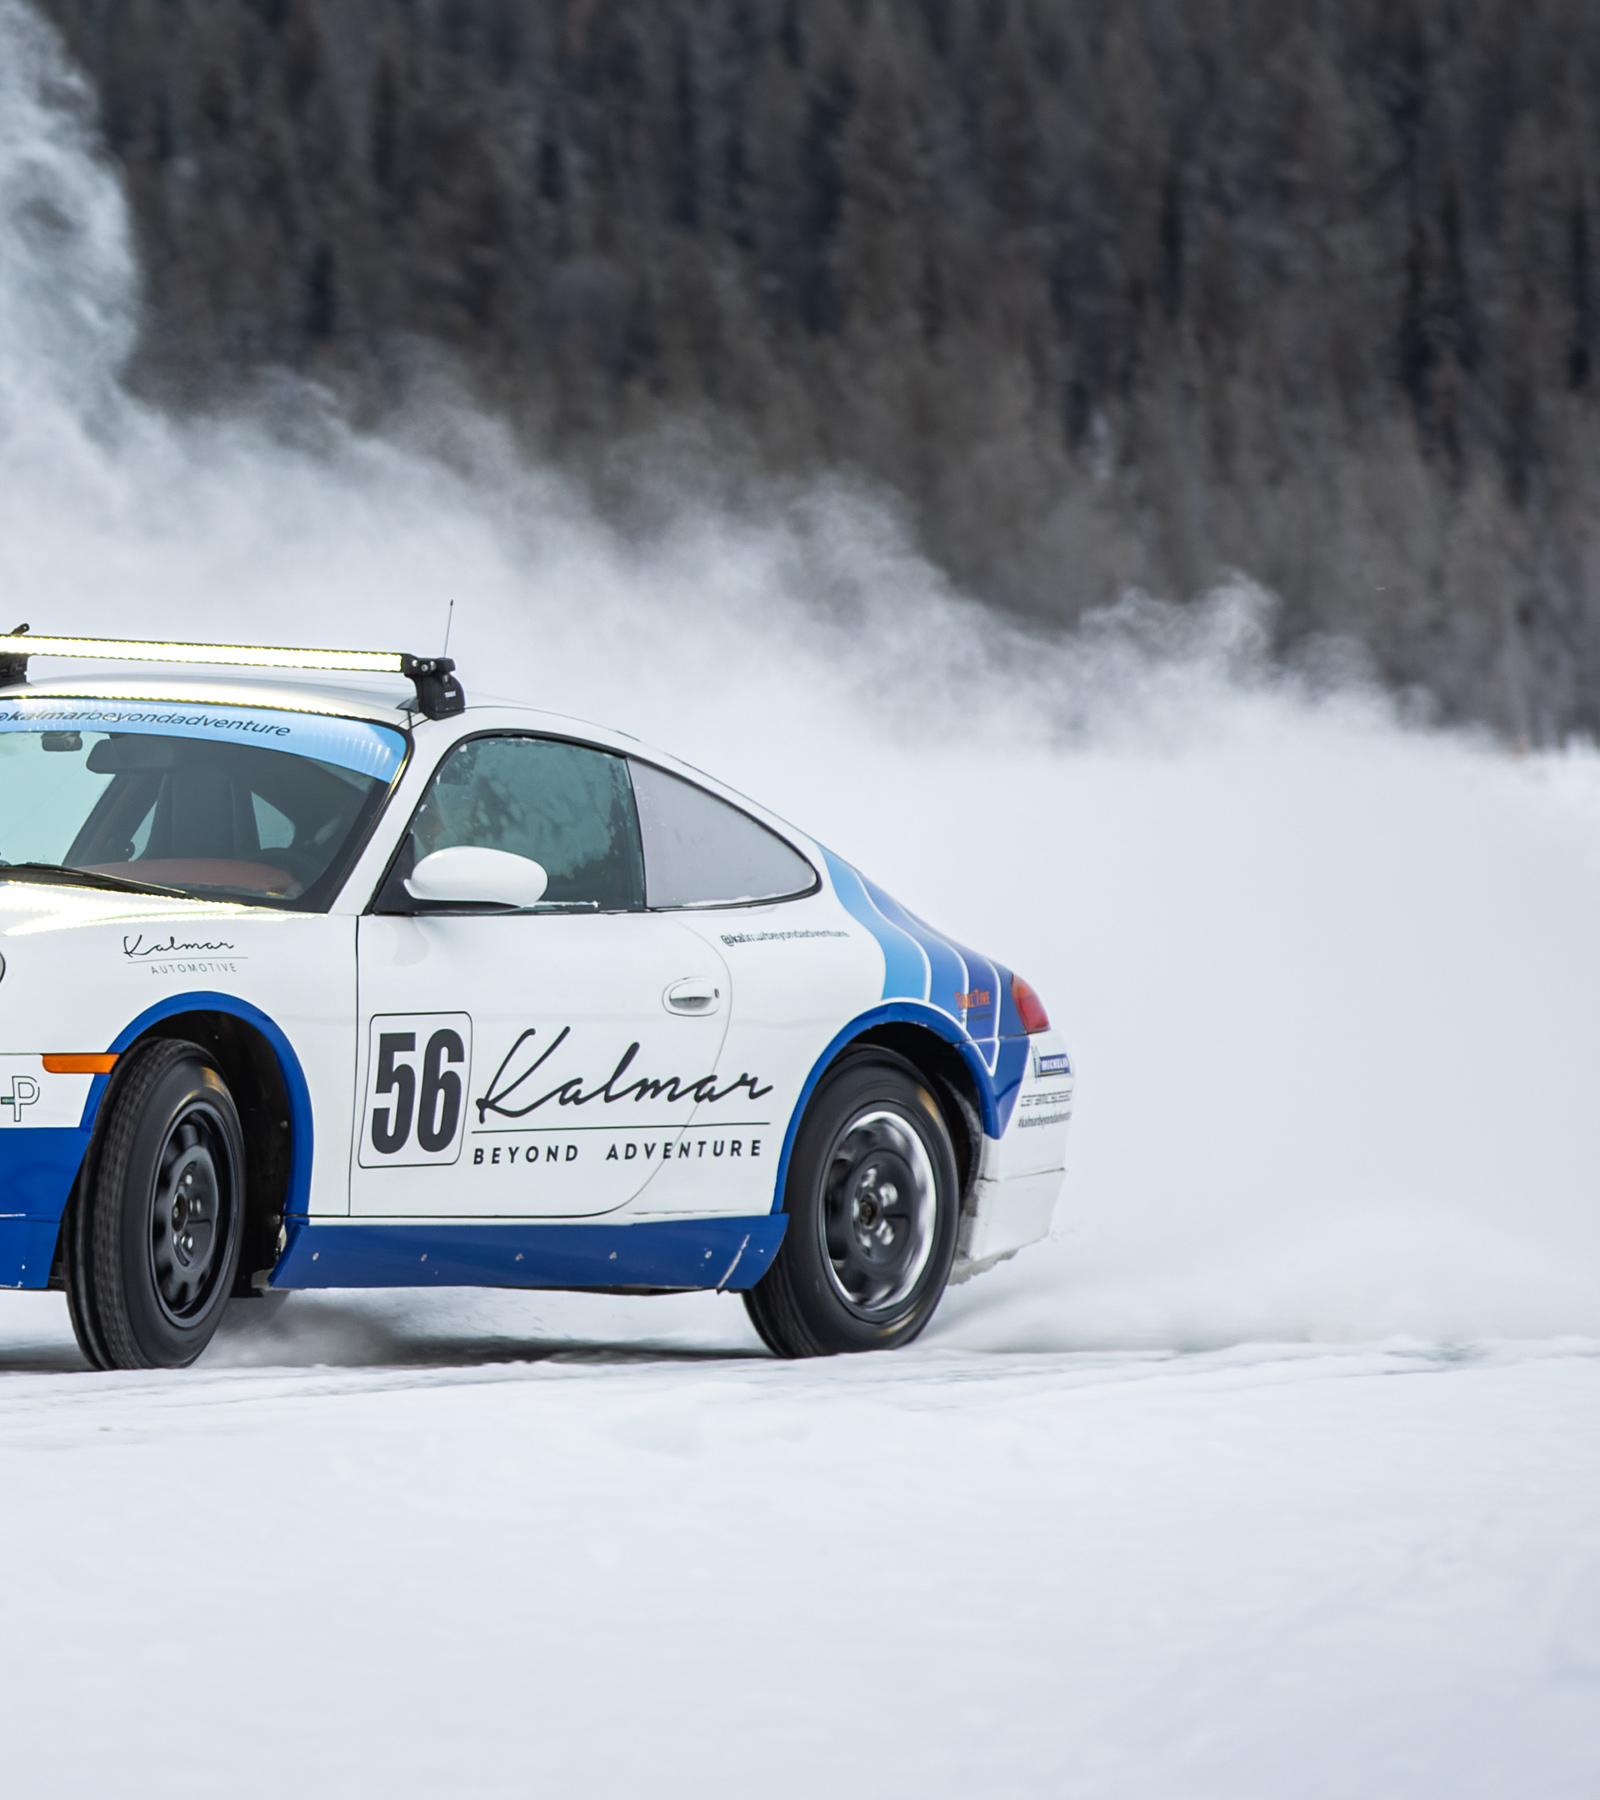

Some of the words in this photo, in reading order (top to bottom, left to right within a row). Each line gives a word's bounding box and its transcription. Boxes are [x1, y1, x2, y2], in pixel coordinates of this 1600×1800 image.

[123, 934, 235, 958] Kalmar
[151, 962, 238, 975] AUTOMOTIVE
[475, 1025, 774, 1124] Kalmar
[371, 1028, 465, 1154] 56
[473, 1144, 579, 1166] BEYOND
[605, 1138, 762, 1162] ADVENTURE
